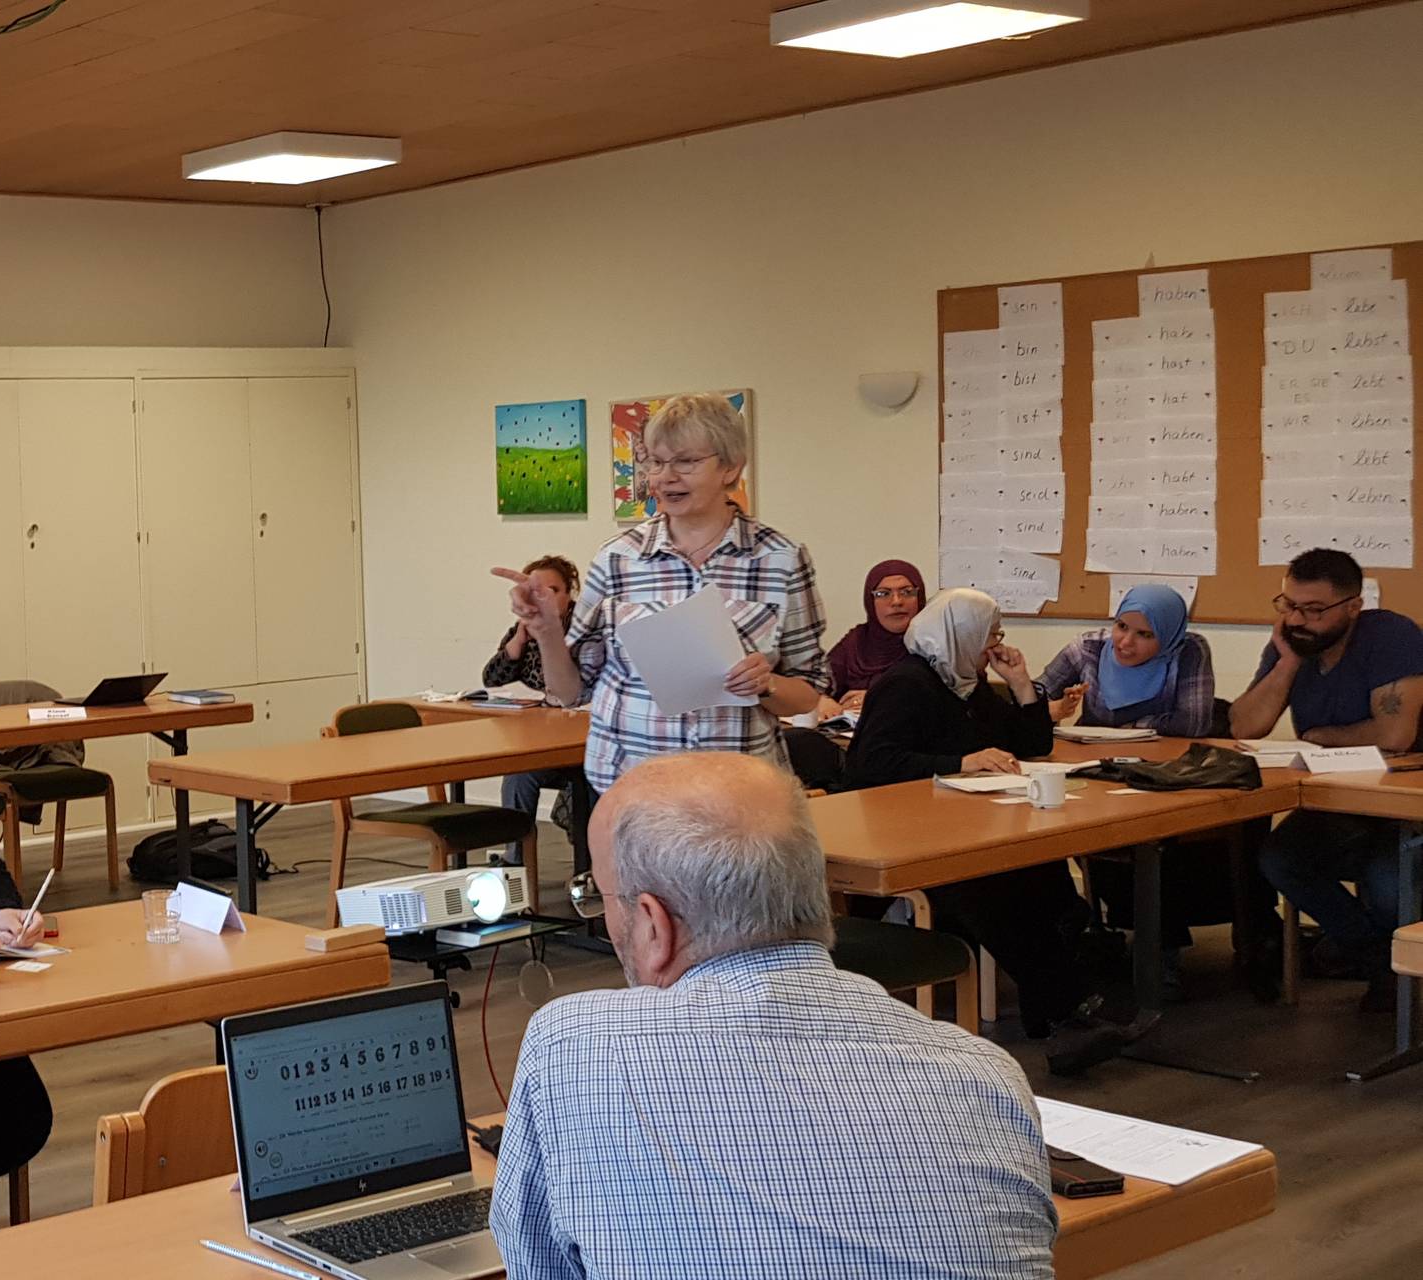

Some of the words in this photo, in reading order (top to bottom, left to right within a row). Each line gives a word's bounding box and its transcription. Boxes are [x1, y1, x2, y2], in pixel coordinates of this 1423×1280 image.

[1154, 285, 1198, 302] haben
[1012, 302, 1038, 313] sein
[1016, 341, 1039, 357] bin
[1161, 356, 1192, 370] hast
[1013, 370, 1037, 386] bist
[1163, 391, 1188, 405] hat
[1016, 408, 1040, 424] ist
[1162, 426, 1204, 441] haben
[1012, 449, 1041, 461] sind
[1162, 470, 1196, 484] habt
[1019, 488, 1049, 502] seid
[1159, 502, 1198, 517] haben
[1017, 521, 1045, 533] sind
[1161, 543, 1197, 558] haben
[1011, 566, 1036, 579] sind
[280, 1065, 290, 1081] 0
[293, 1063, 301, 1079] 1
[305, 1060, 315, 1076] 2
[320, 1057, 331, 1073] 3
[339, 1053, 349, 1069] 4
[357, 1050, 367, 1066] 5
[375, 1046, 385, 1063] 6
[391, 1043, 401, 1060] 7
[409, 1040, 419, 1056] 8
[426, 1036, 435, 1052] 9
[295, 1097, 306, 1112] 11
[308, 1095, 321, 1109] 12
[323, 1091, 337, 1106] 13
[341, 1087, 355, 1102] 14
[360, 1083, 374, 1098] 15
[378, 1080, 391, 1094] 16
[396, 1077, 408, 1091] 17
[412, 1073, 425, 1087] 18
[429, 1070, 442, 1083] 19
